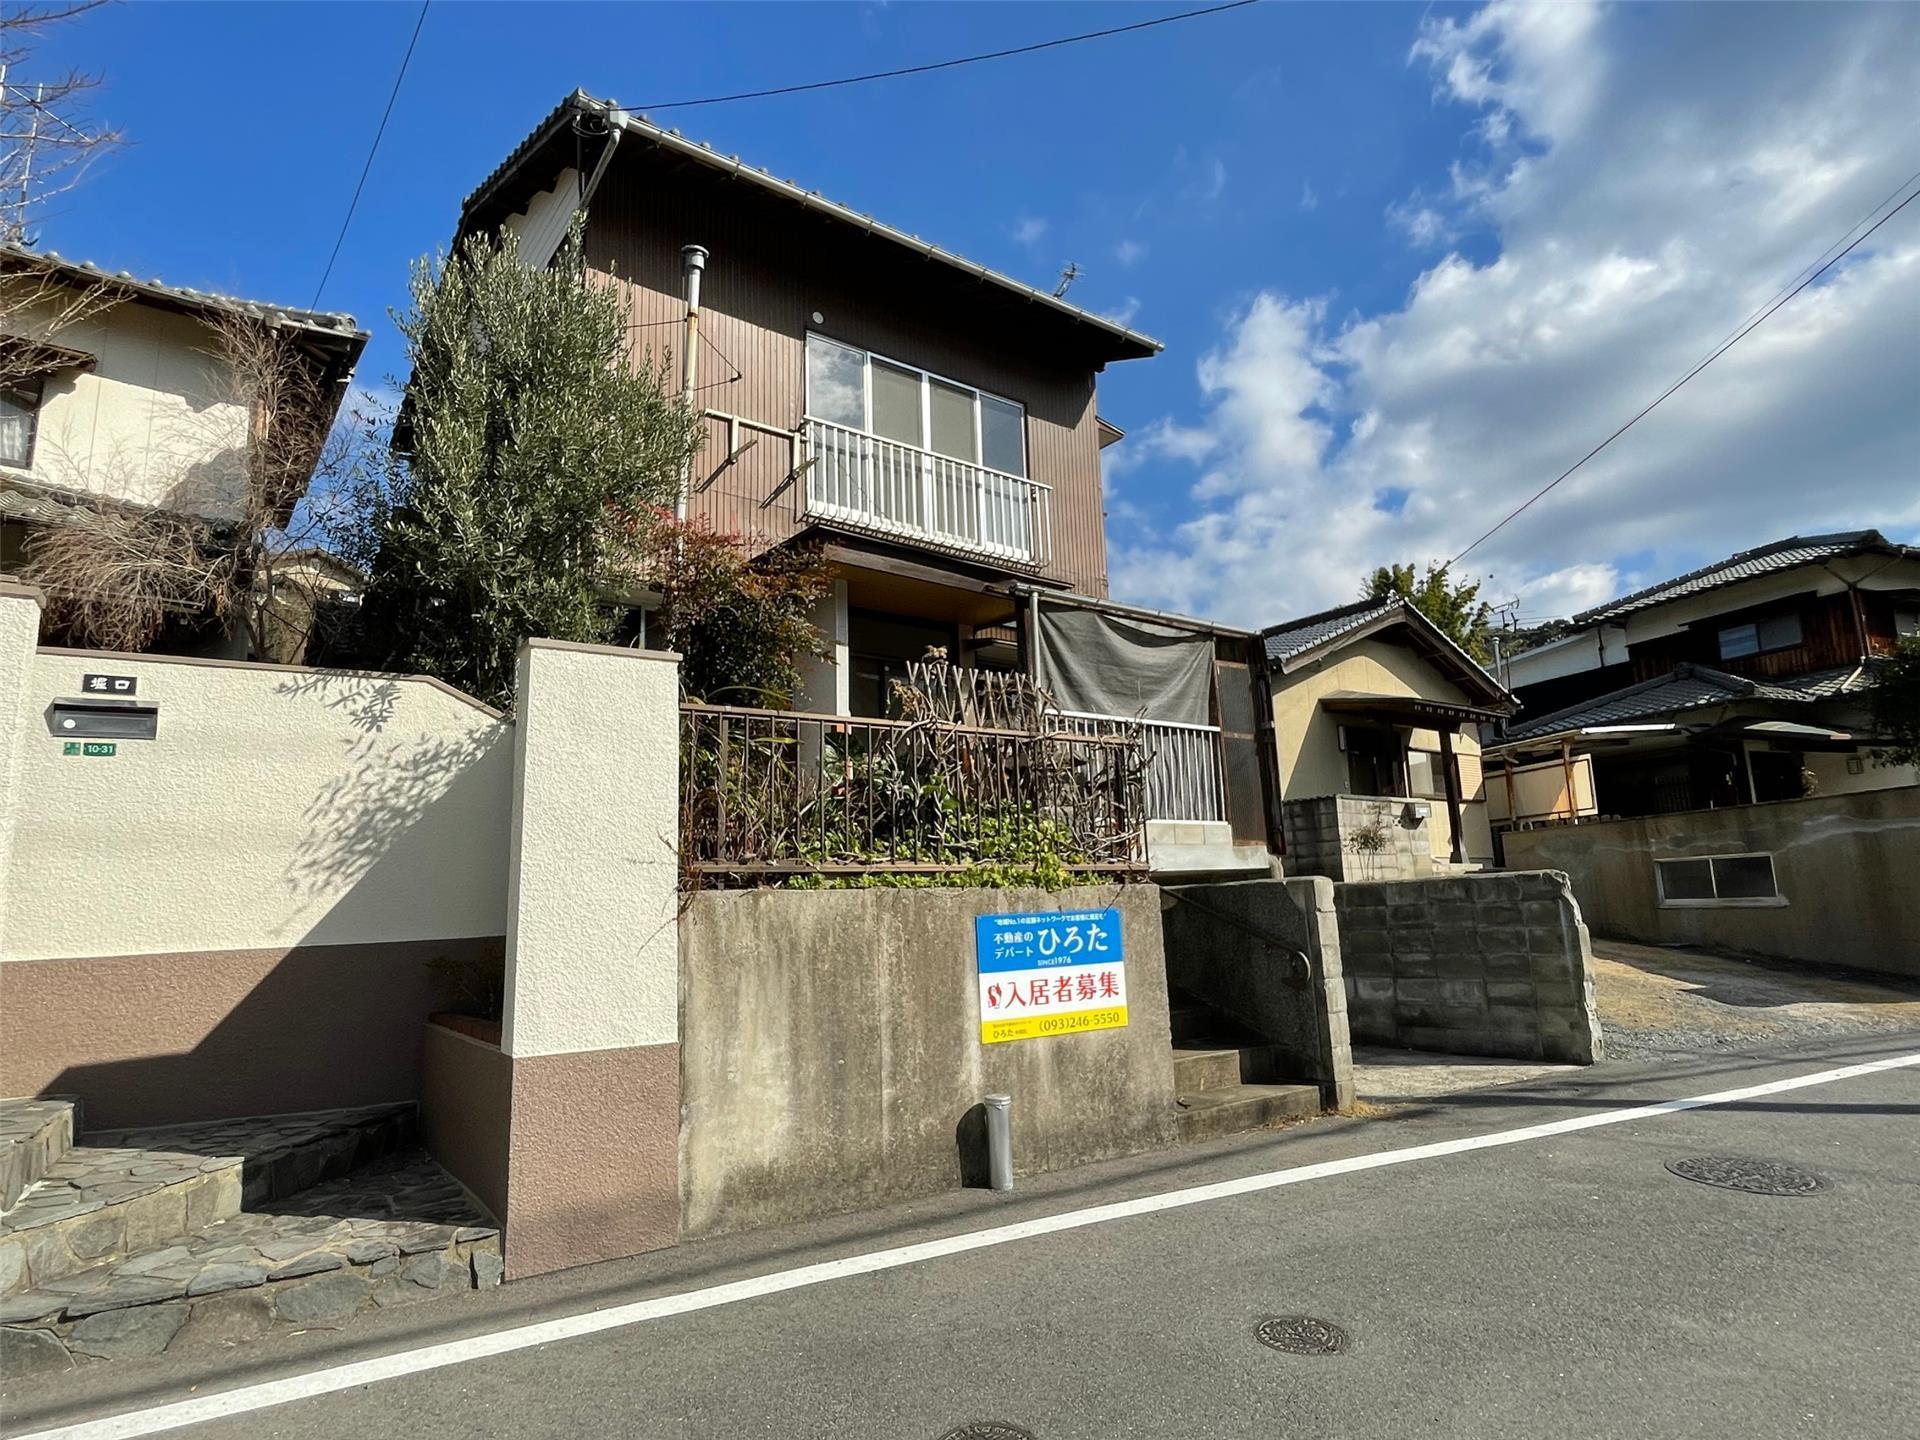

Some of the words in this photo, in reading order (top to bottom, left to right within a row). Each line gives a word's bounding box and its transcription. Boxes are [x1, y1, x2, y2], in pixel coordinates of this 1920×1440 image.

[87, 745, 114, 754] 10-31
[993, 931, 1034, 945] 不動産の
[1037, 922, 1109, 955] ひろた
[994, 946, 1034, 960] デパート
[1004, 971, 1120, 1009] 入居者募集
[1039, 1012, 1120, 1032] (093)246-5550
